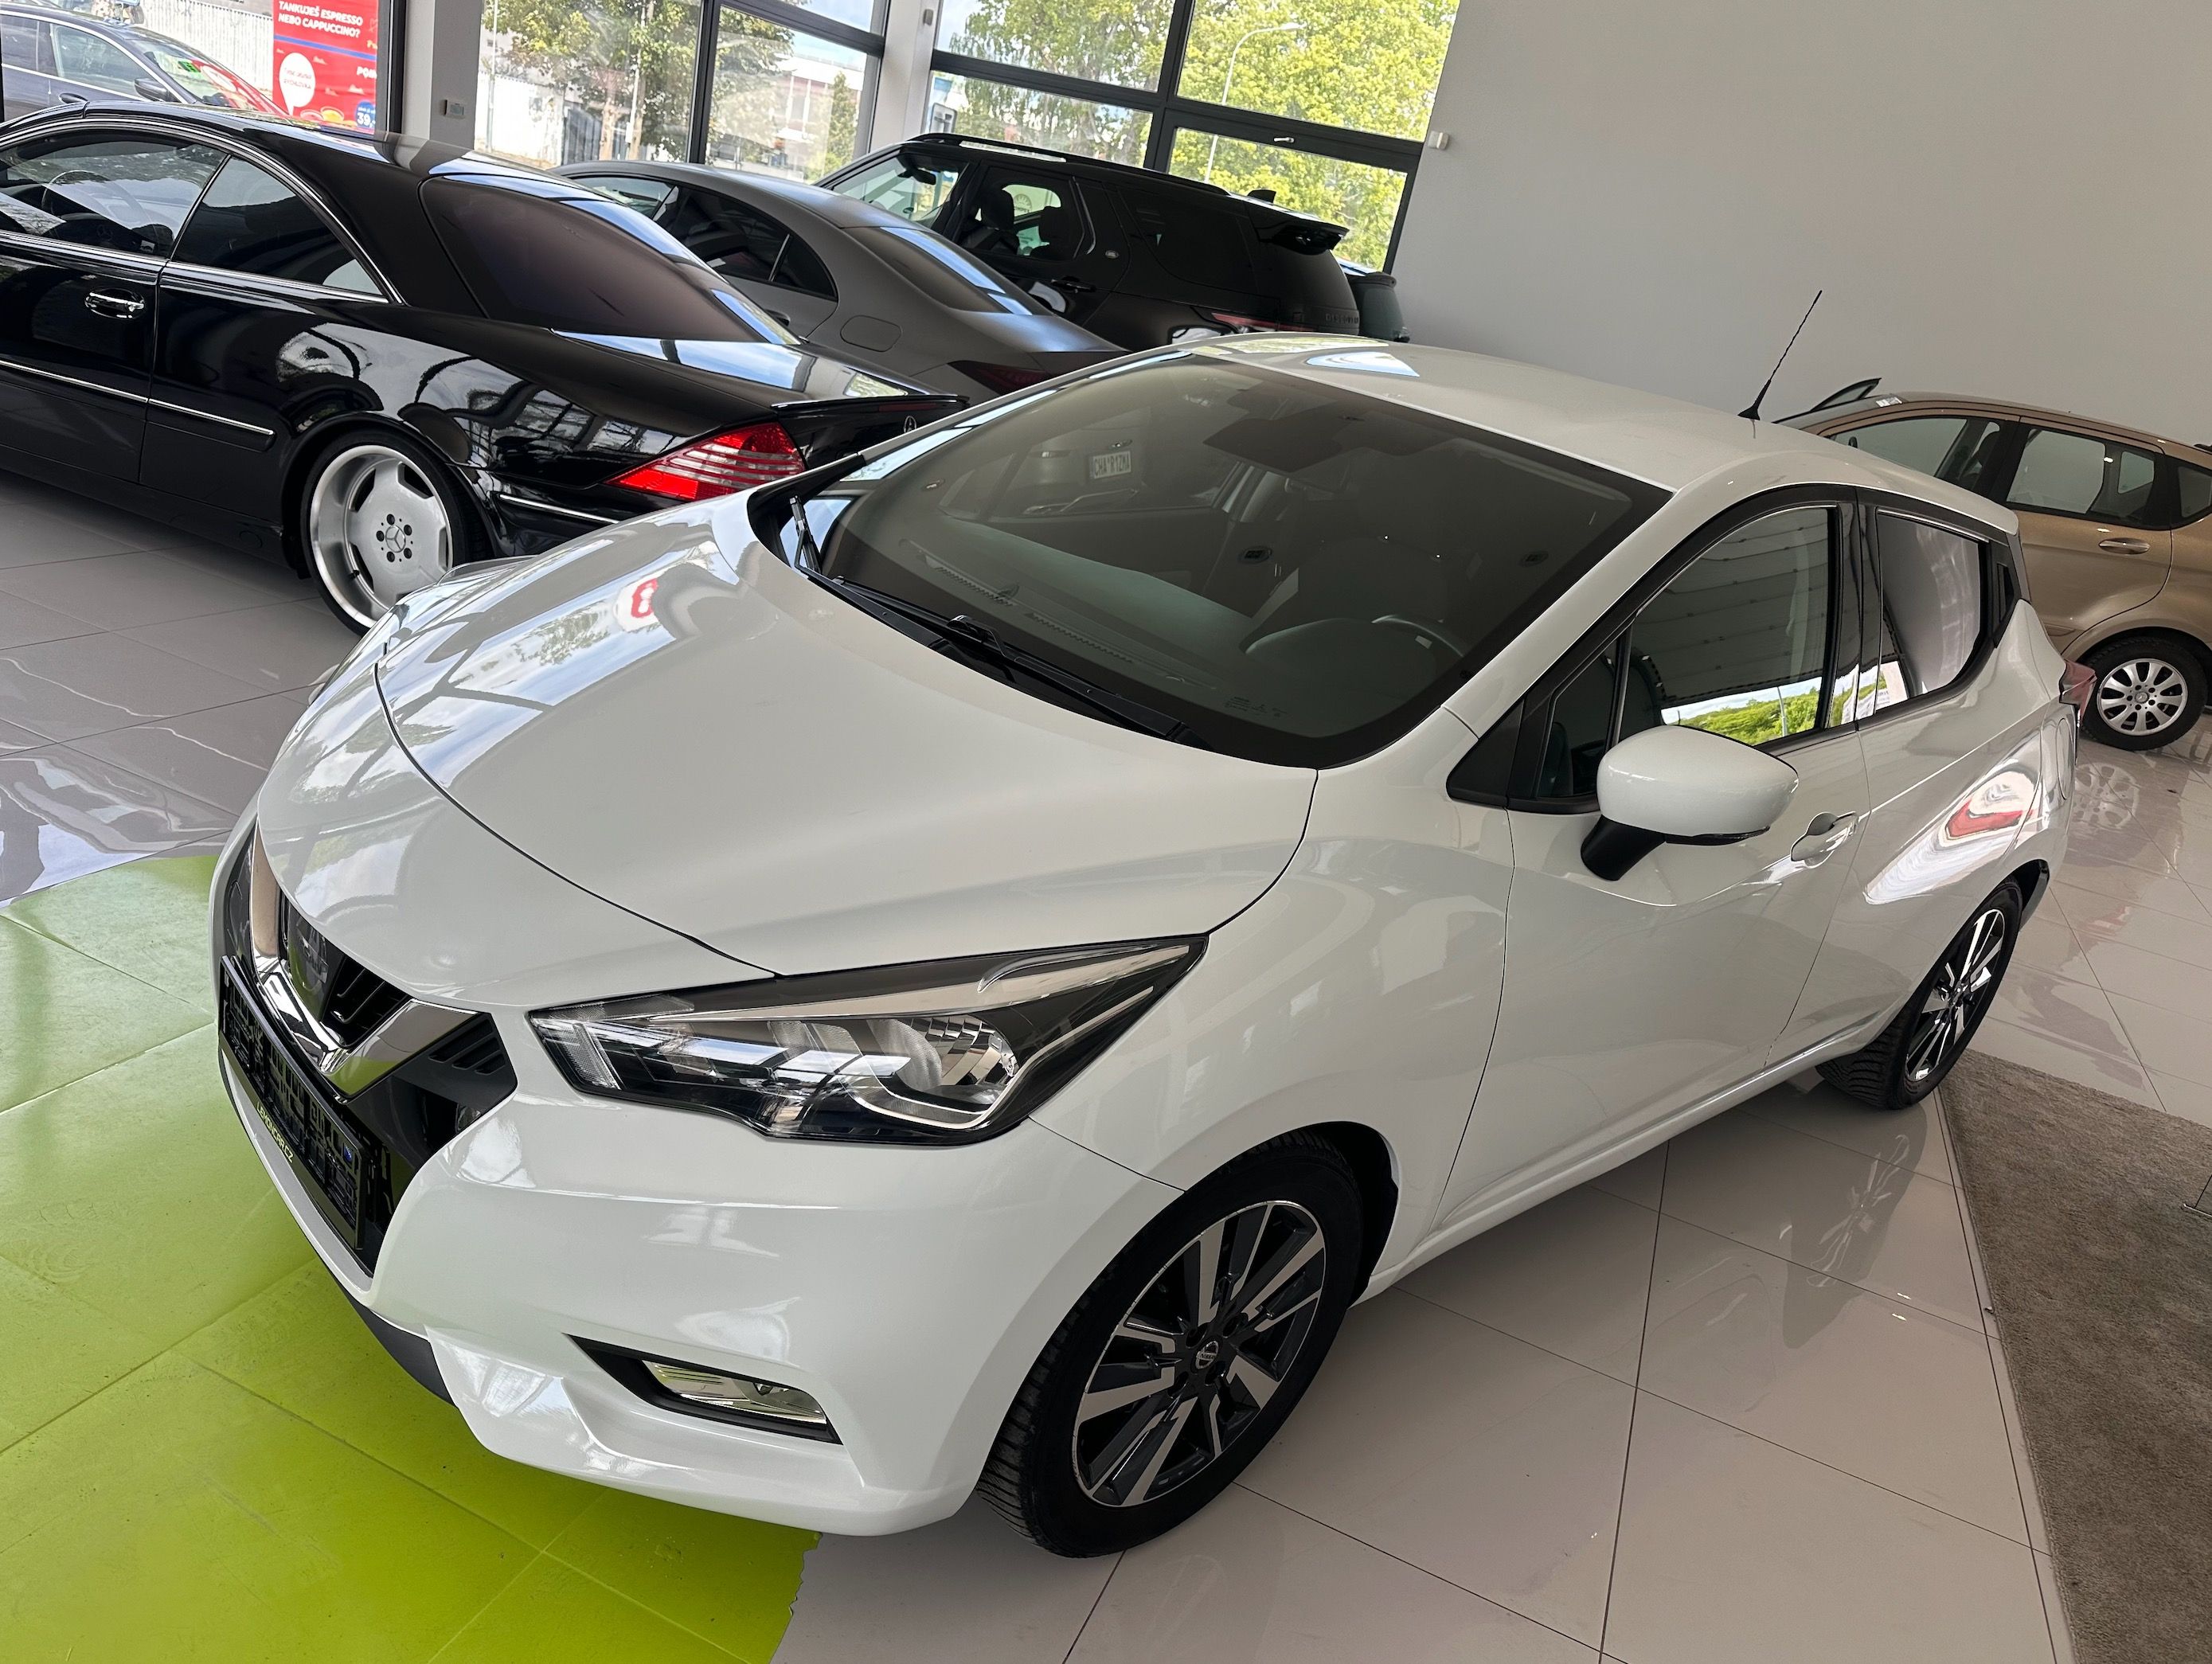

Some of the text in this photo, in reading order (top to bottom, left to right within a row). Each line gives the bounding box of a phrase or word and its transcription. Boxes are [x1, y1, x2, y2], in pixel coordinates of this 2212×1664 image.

[278, 13, 361, 38] NEBO CAPPUCCINO?
[279, 1, 364, 26] TANKUJEŠ ESPRESSO
[256, 1101, 295, 1163] LEMONCAR.CZ
